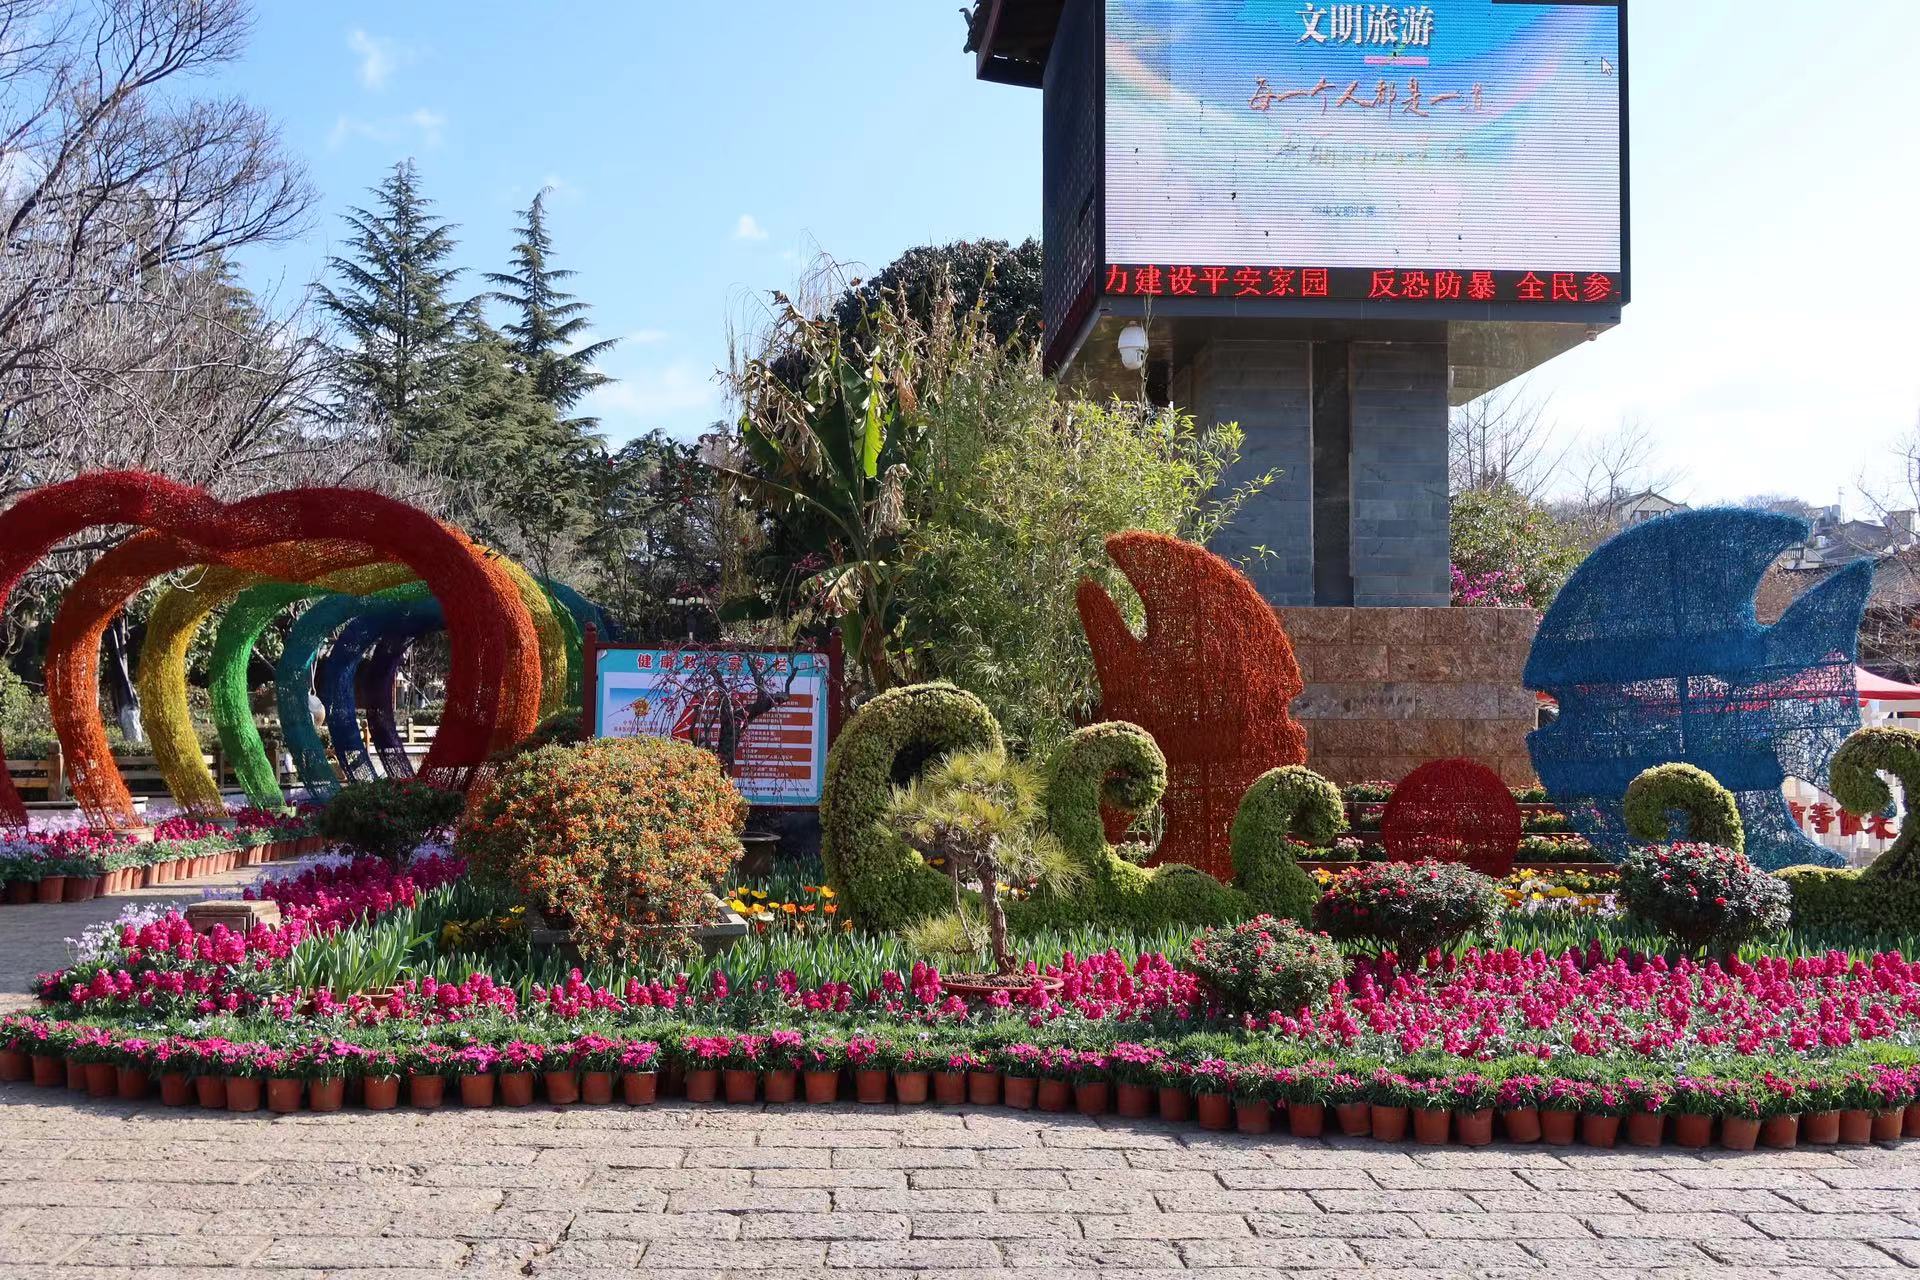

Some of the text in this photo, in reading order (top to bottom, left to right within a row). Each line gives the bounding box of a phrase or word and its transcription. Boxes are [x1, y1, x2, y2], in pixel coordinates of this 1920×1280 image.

[1295, 3, 1434, 46] 文明旅游
[1105, 264, 1620, 302] 力建设平安家园 反恐防暴 全民参
